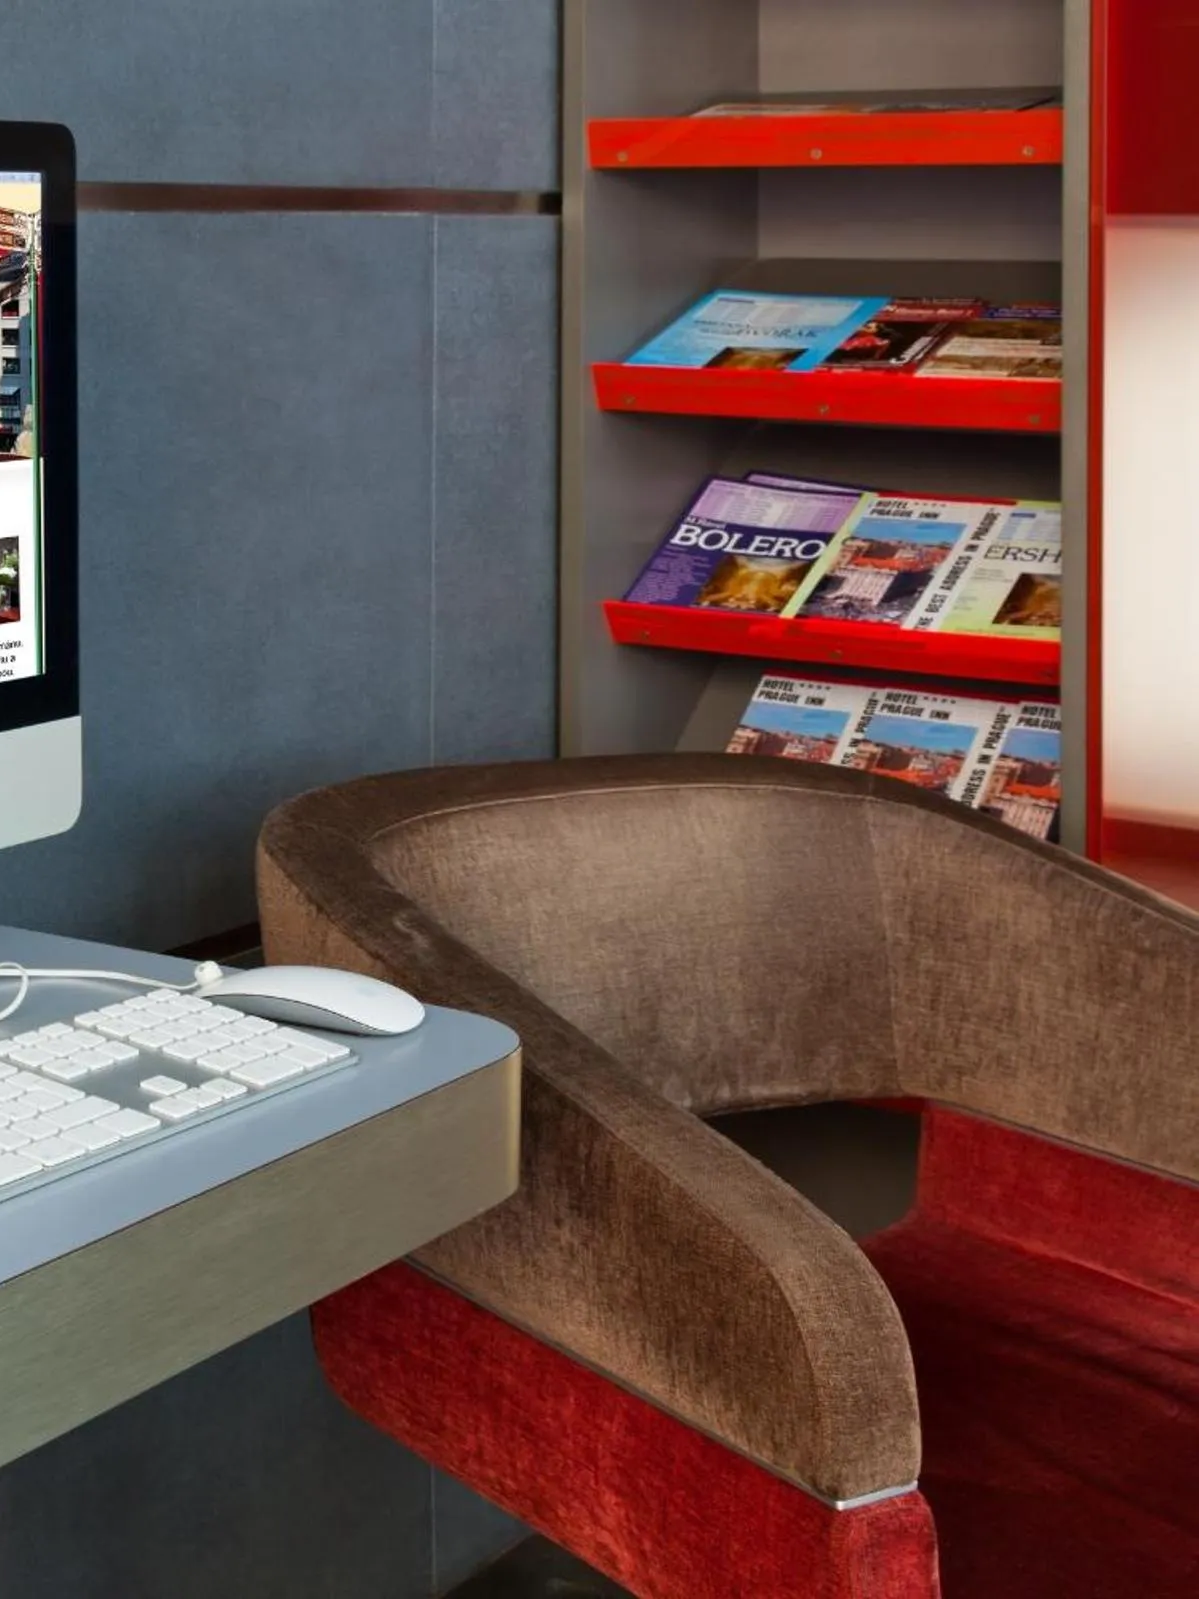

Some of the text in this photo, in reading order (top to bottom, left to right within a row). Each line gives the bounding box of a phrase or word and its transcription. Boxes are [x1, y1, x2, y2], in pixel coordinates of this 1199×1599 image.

[875, 500, 909, 510] HOTEL
[869, 508, 913, 519] PRAGUE
[669, 523, 829, 561] BOLERO
[983, 544, 1062, 564] ERSH
[940, 554, 973, 591] ADDRESS
[964, 543, 980, 553] IN
[762, 679, 795, 692] HOTEL
[757, 689, 801, 704] PRAGUE
[884, 691, 919, 705] HOTEL
[879, 702, 951, 721] PRAGUE INN
[1021, 705, 1057, 719] HOTEL
[1016, 716, 1063, 731] PRAGU
[977, 754, 993, 765] IN
